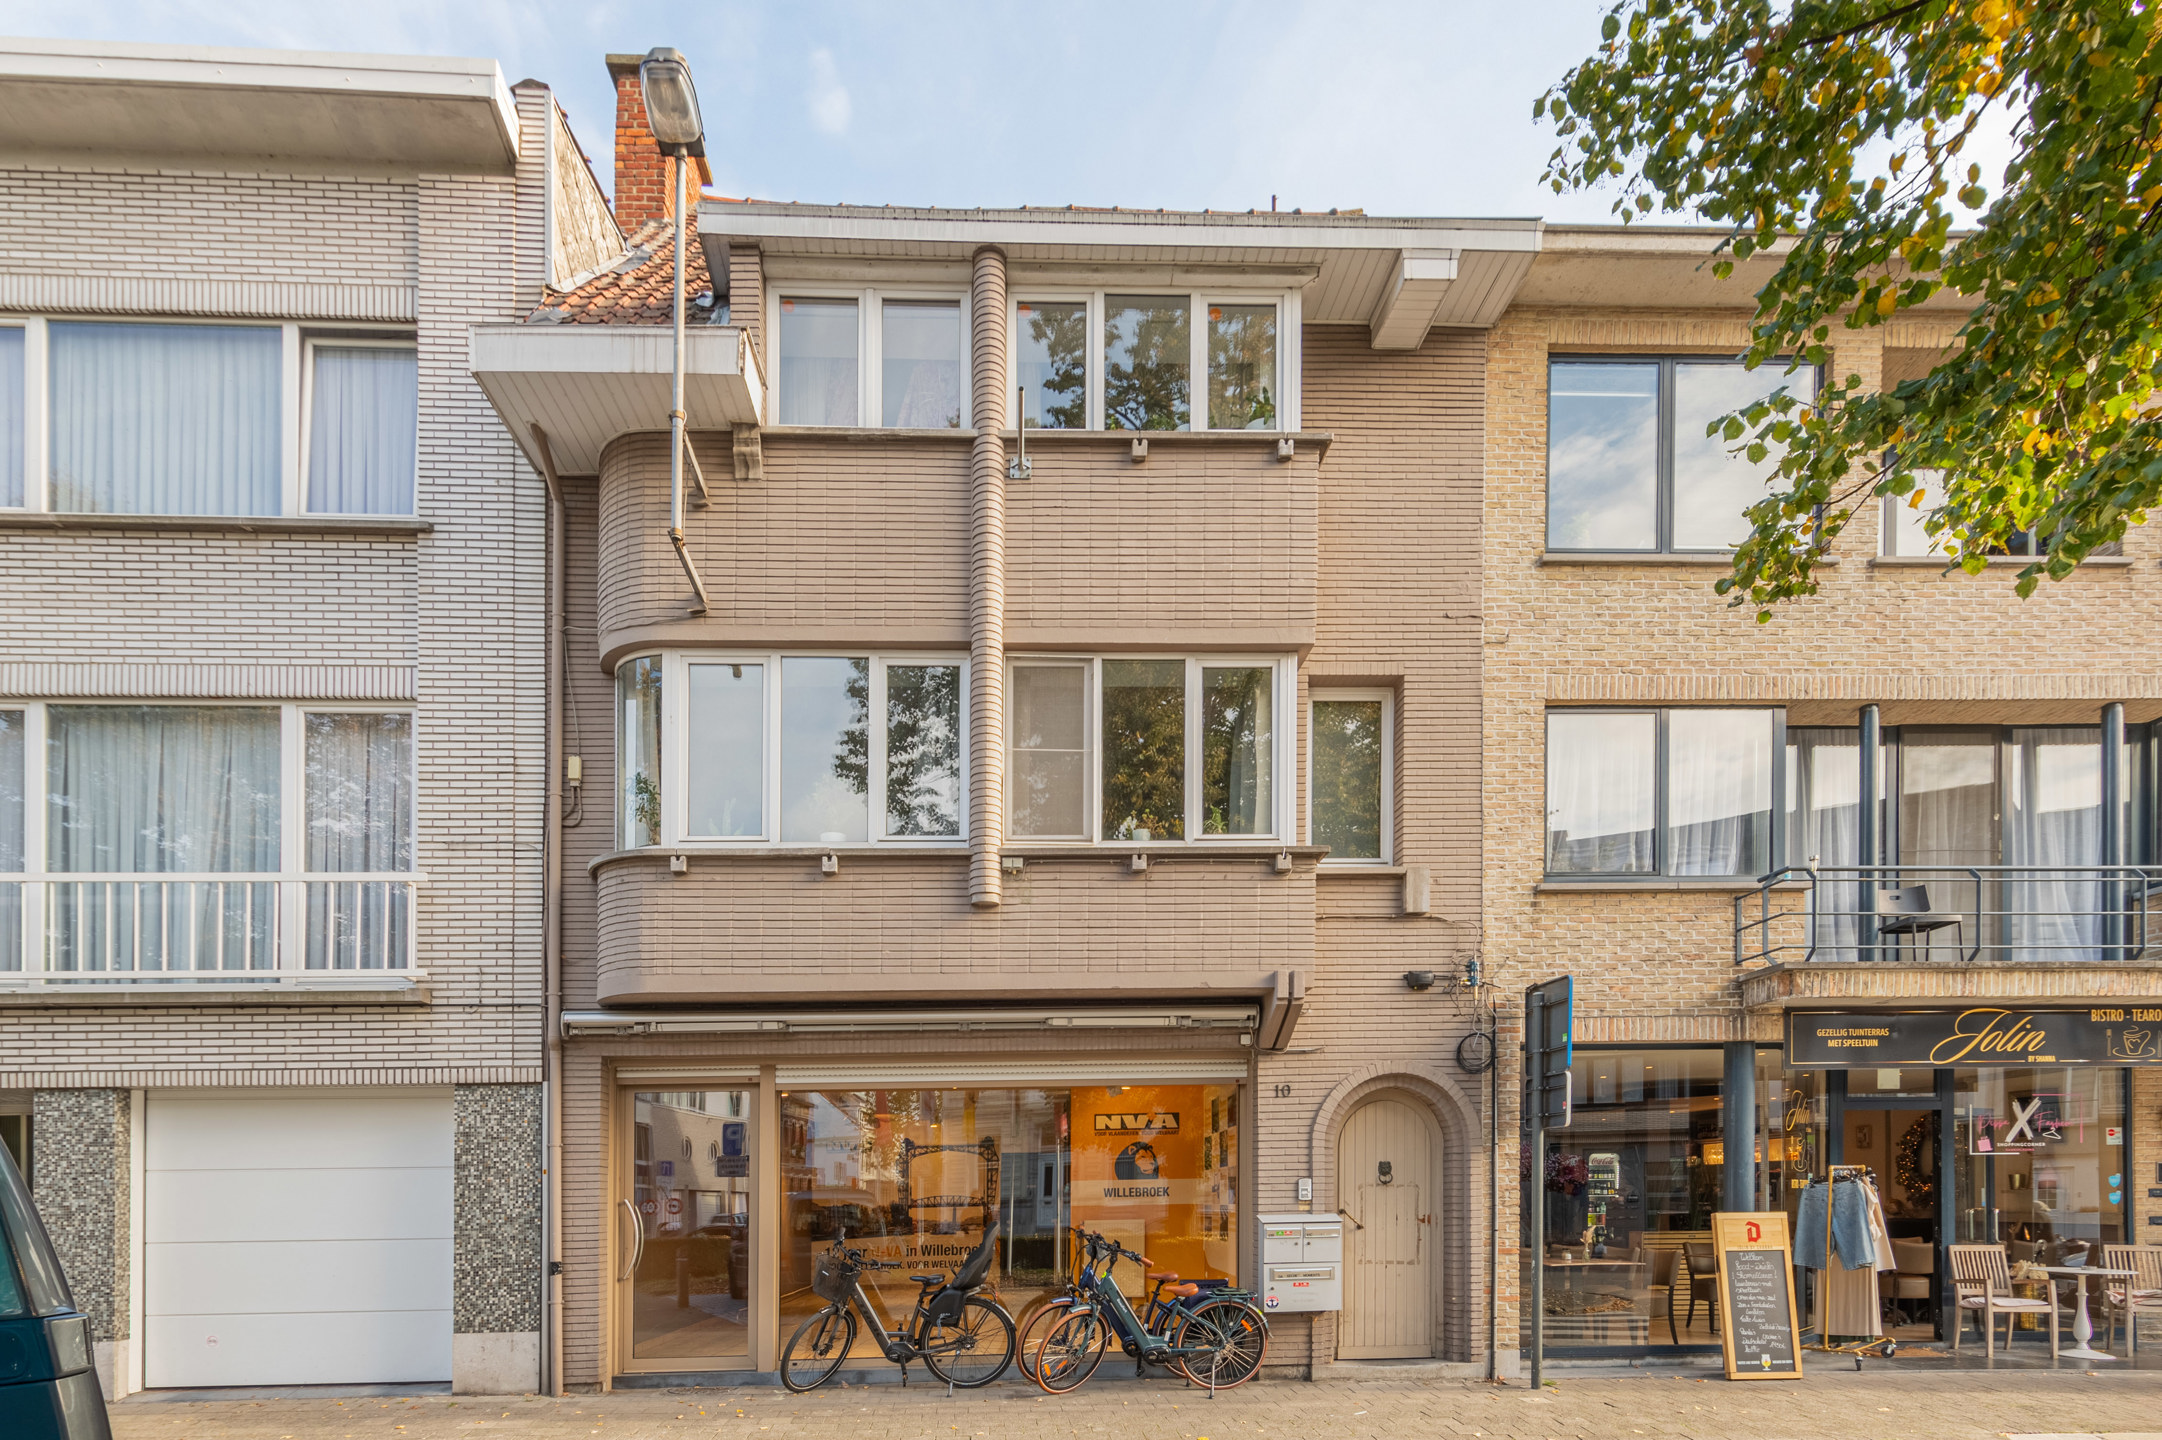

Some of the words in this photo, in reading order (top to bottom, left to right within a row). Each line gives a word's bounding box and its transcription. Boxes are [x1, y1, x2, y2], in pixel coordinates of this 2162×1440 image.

[2091, 1009, 2124, 1022] BISTRO
[1817, 1029, 1848, 1037] GEZELLIG
[1848, 1028, 1890, 1037] TUINTERRAS
[1929, 1008, 2046, 1065] Jolin
[1828, 1039, 1842, 1047] MET
[1843, 1039, 1879, 1047] SPEELTUIN
[2028, 1055, 2036, 1063] BY
[1274, 1084, 1291, 1098] 10
[1103, 1186, 1170, 1198] WILLEBROEK
[906, 1244, 917, 1257] in
[921, 1242, 980, 1257] Willebro
[907, 1260, 930, 1270] VOOR
